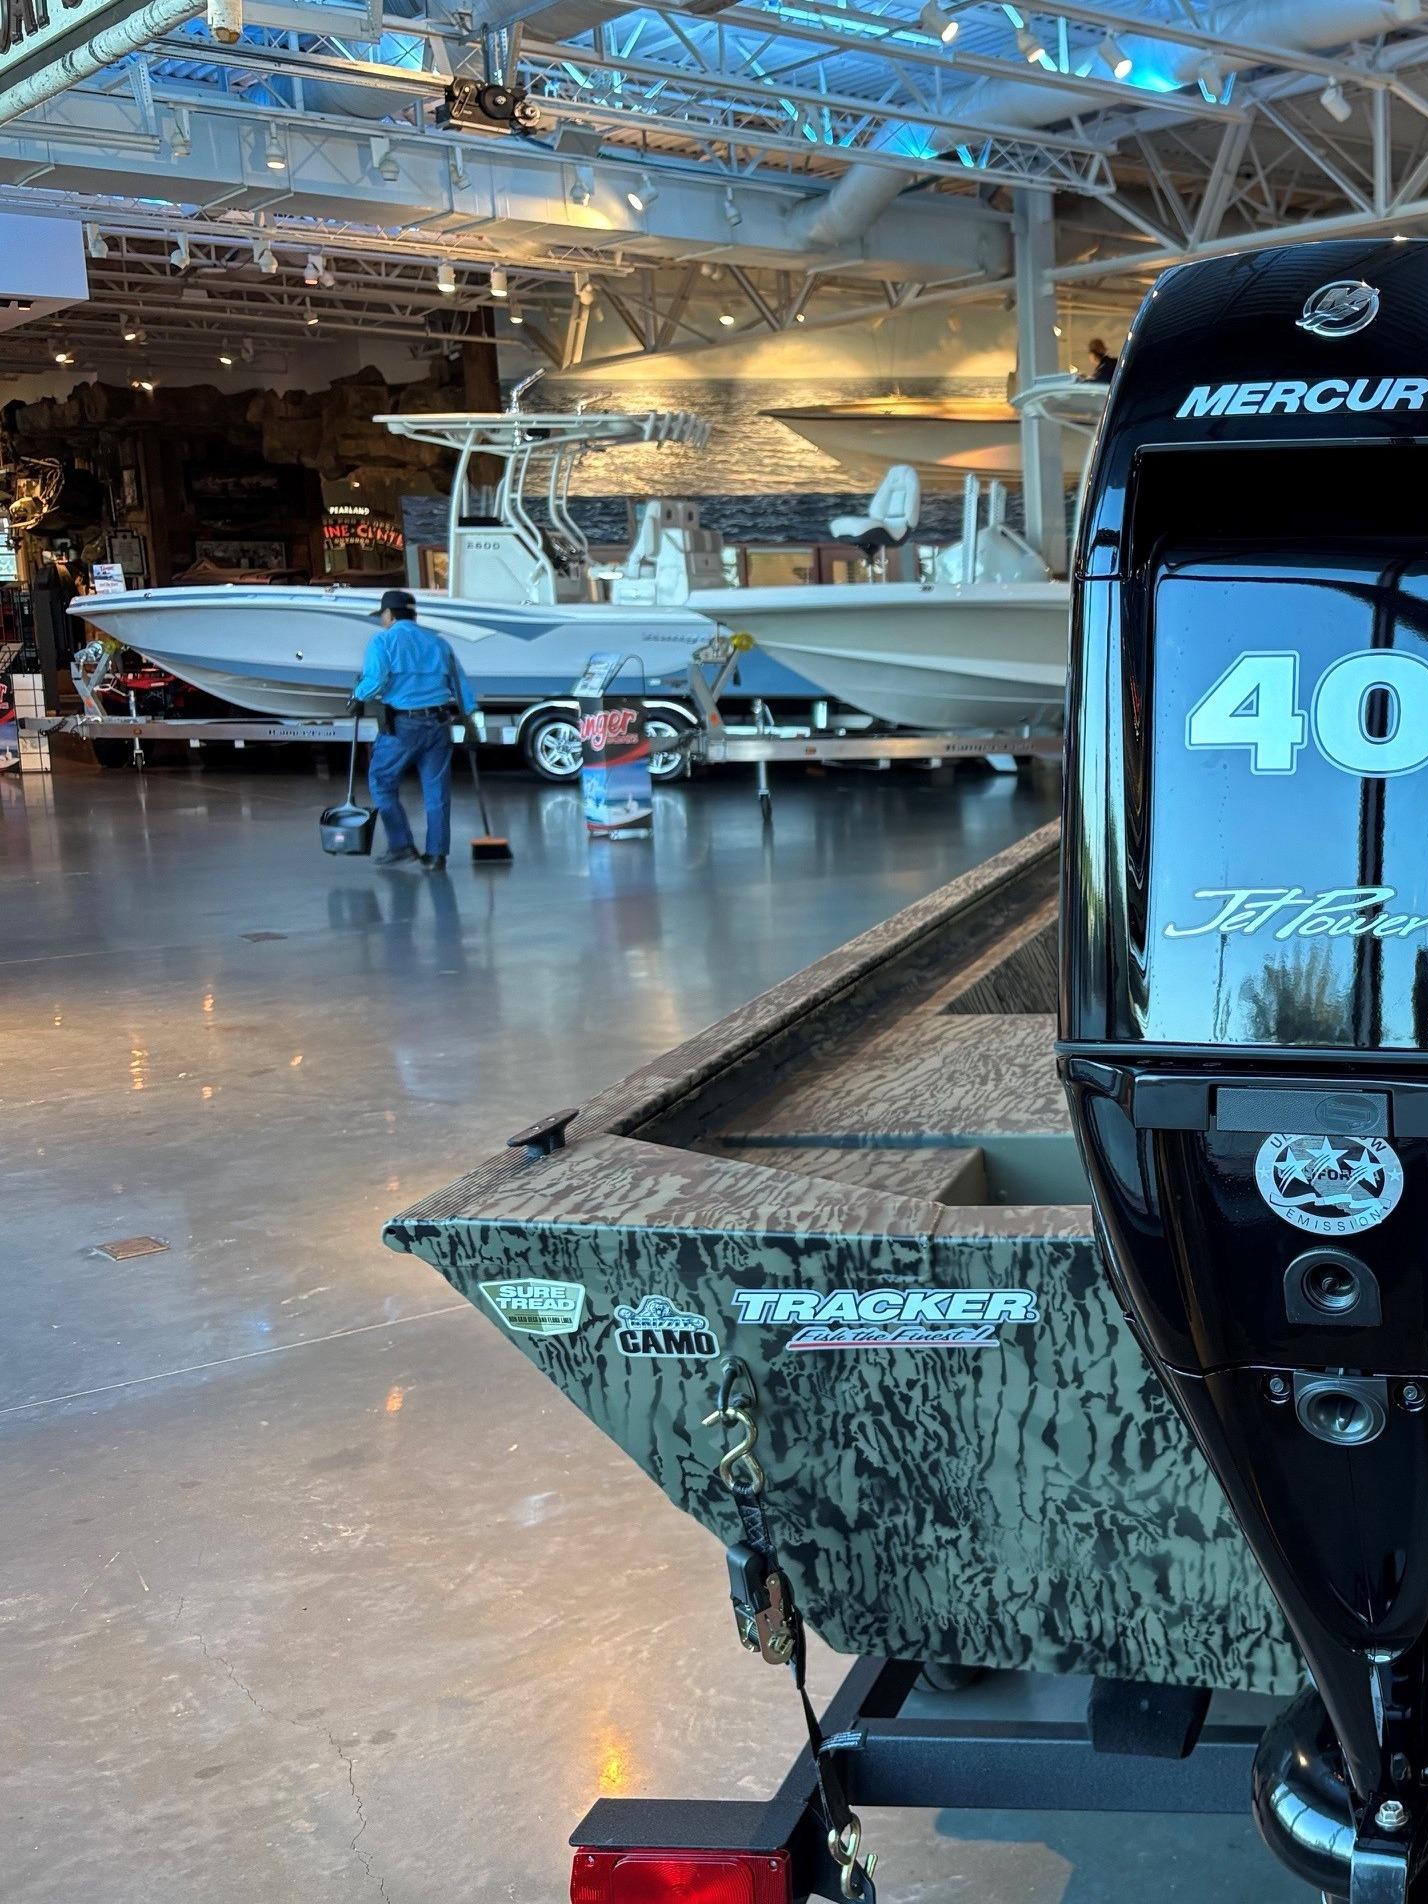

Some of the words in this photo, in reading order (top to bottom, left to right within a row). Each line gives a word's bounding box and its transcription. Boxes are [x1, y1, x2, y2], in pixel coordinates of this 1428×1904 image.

[329, 506, 370, 515] PEARLAND
[1164, 887, 1313, 937] Jet
[499, 1285, 566, 1299] SURE
[495, 1297, 575, 1311] TREAD
[733, 1291, 1034, 1322] TRACKER
[798, 1327, 848, 1341] Fish
[851, 1327, 886, 1341] the
[619, 1328, 717, 1355] CAMO
